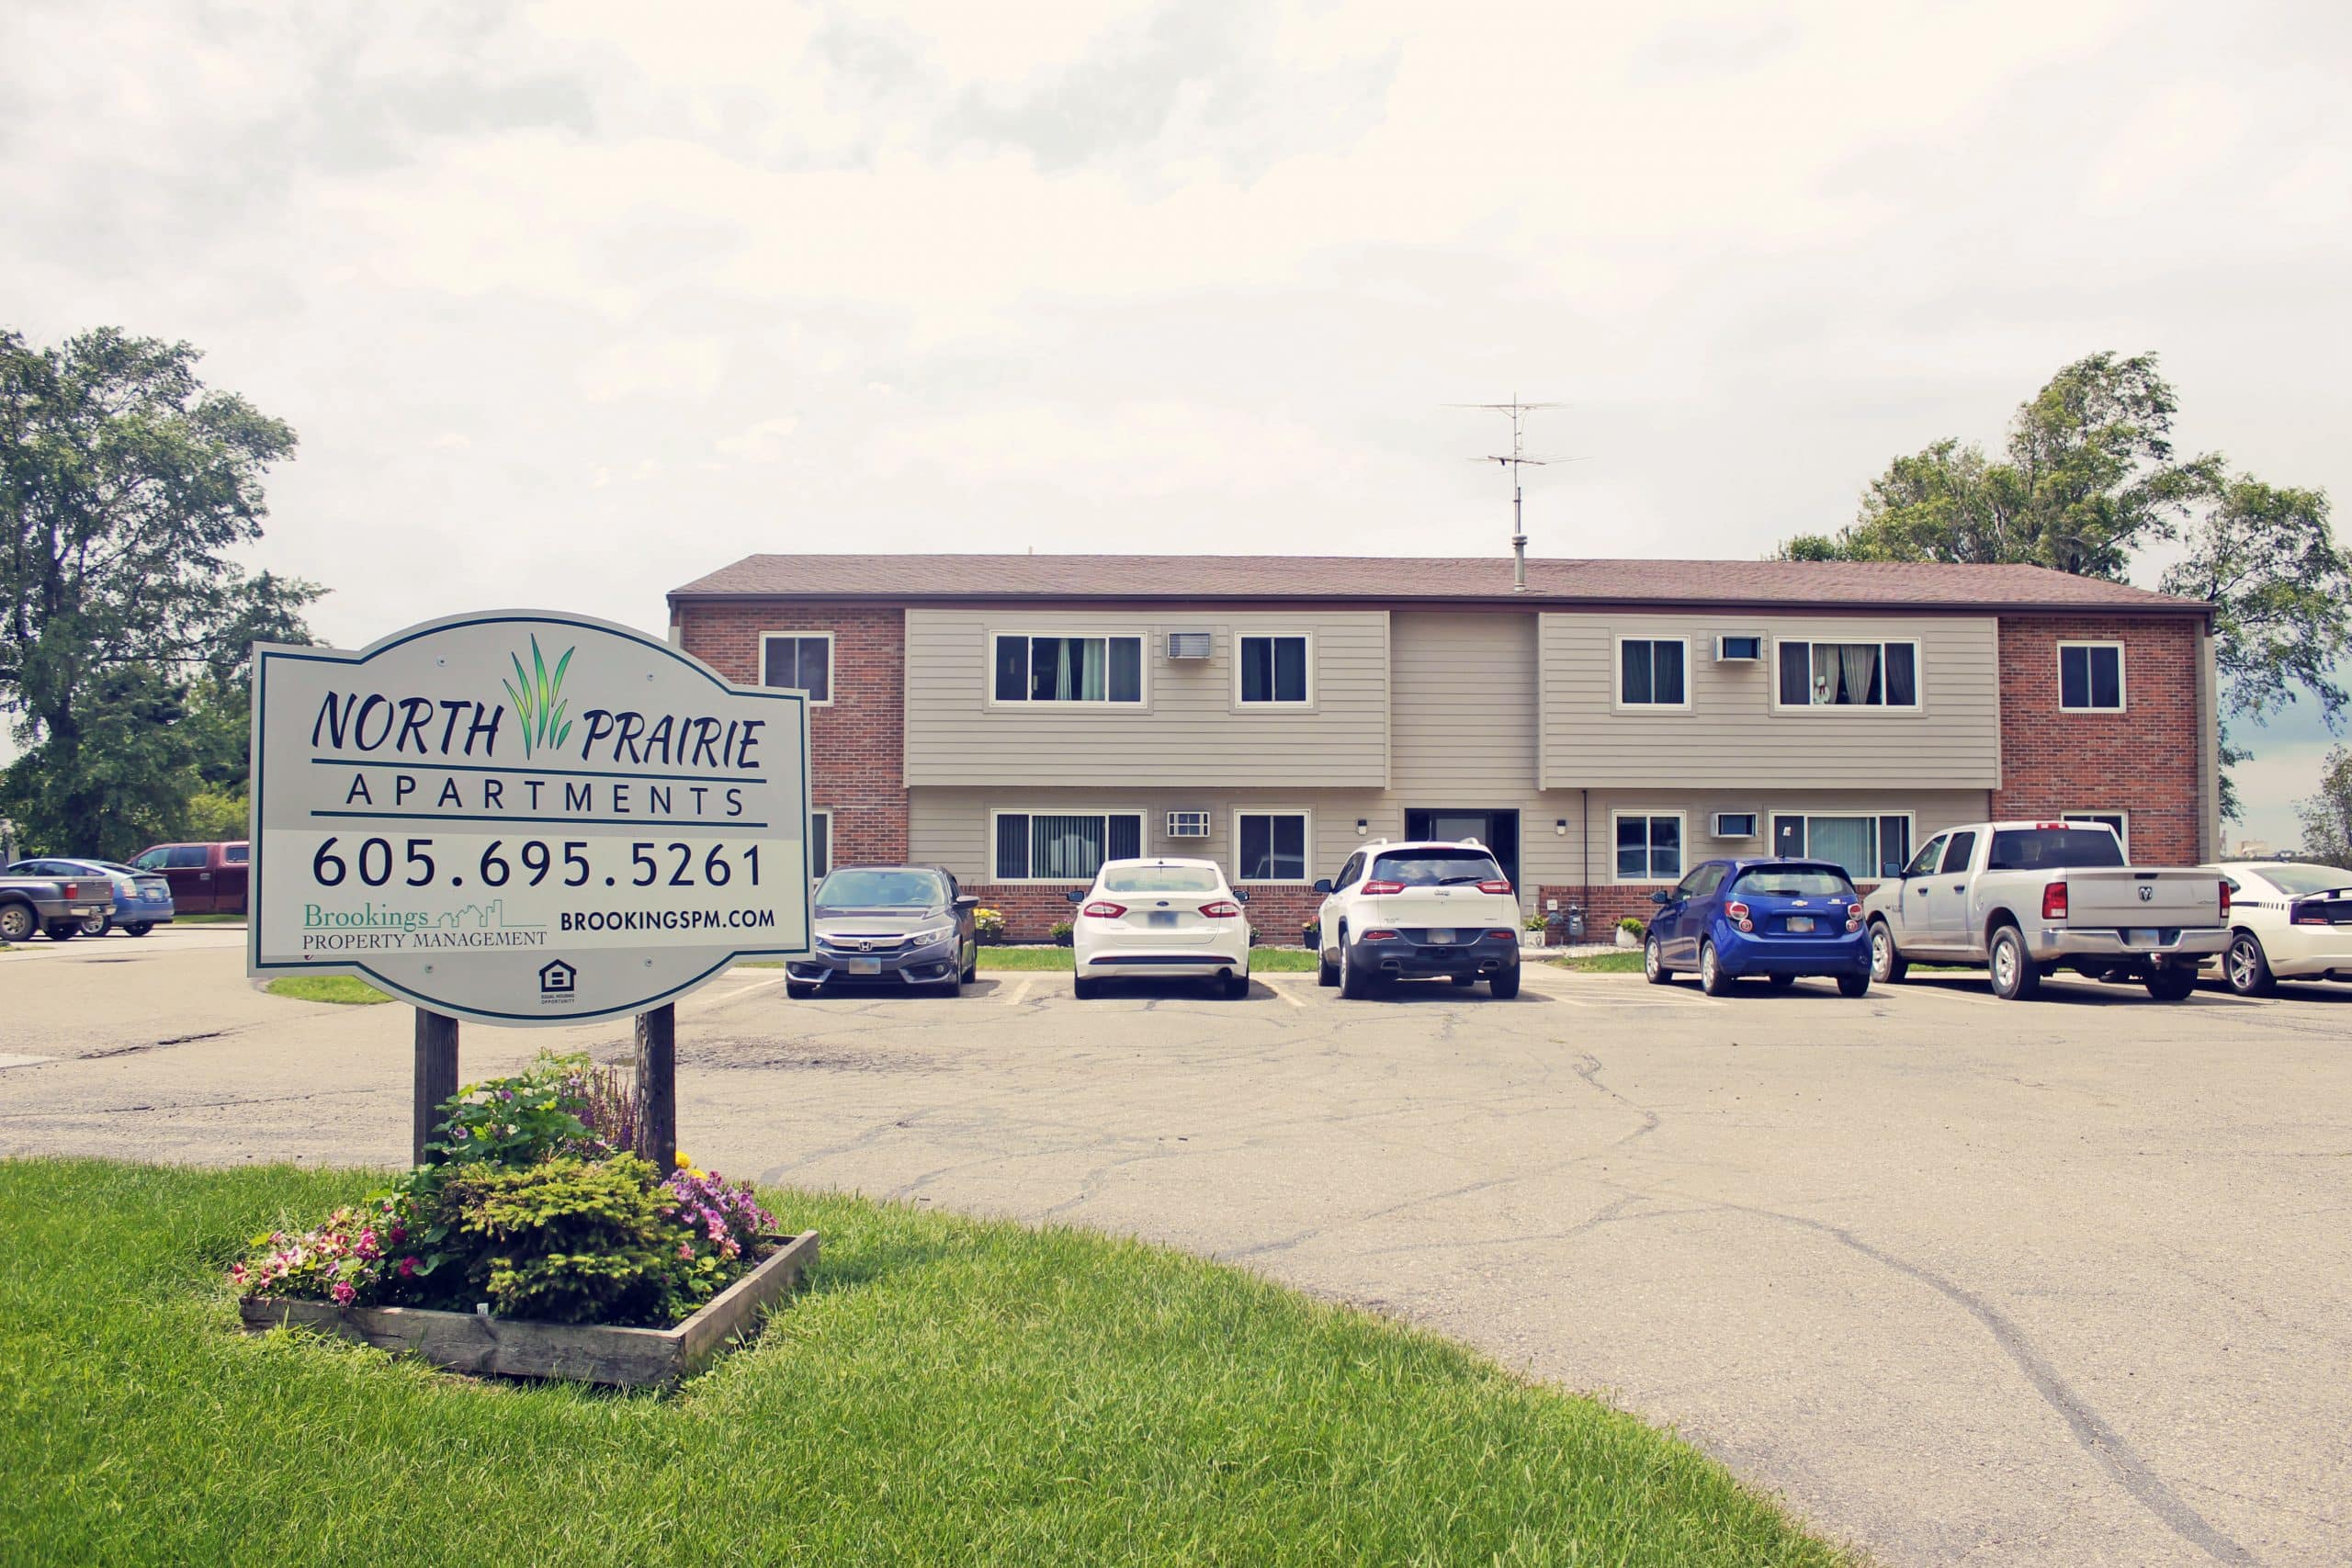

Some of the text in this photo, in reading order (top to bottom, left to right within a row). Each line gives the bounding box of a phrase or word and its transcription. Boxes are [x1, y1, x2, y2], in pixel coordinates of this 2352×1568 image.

[311, 690, 766, 769] NORTH PRAIRIE
[345, 773, 743, 817] APARTMENTS
[312, 837, 761, 887] 605.695.5261
[304, 902, 429, 933] Brookings
[560, 909, 775, 931] BROOKINGSPM.COM
[302, 931, 548, 950] PROPERTY MANAGEMENT
